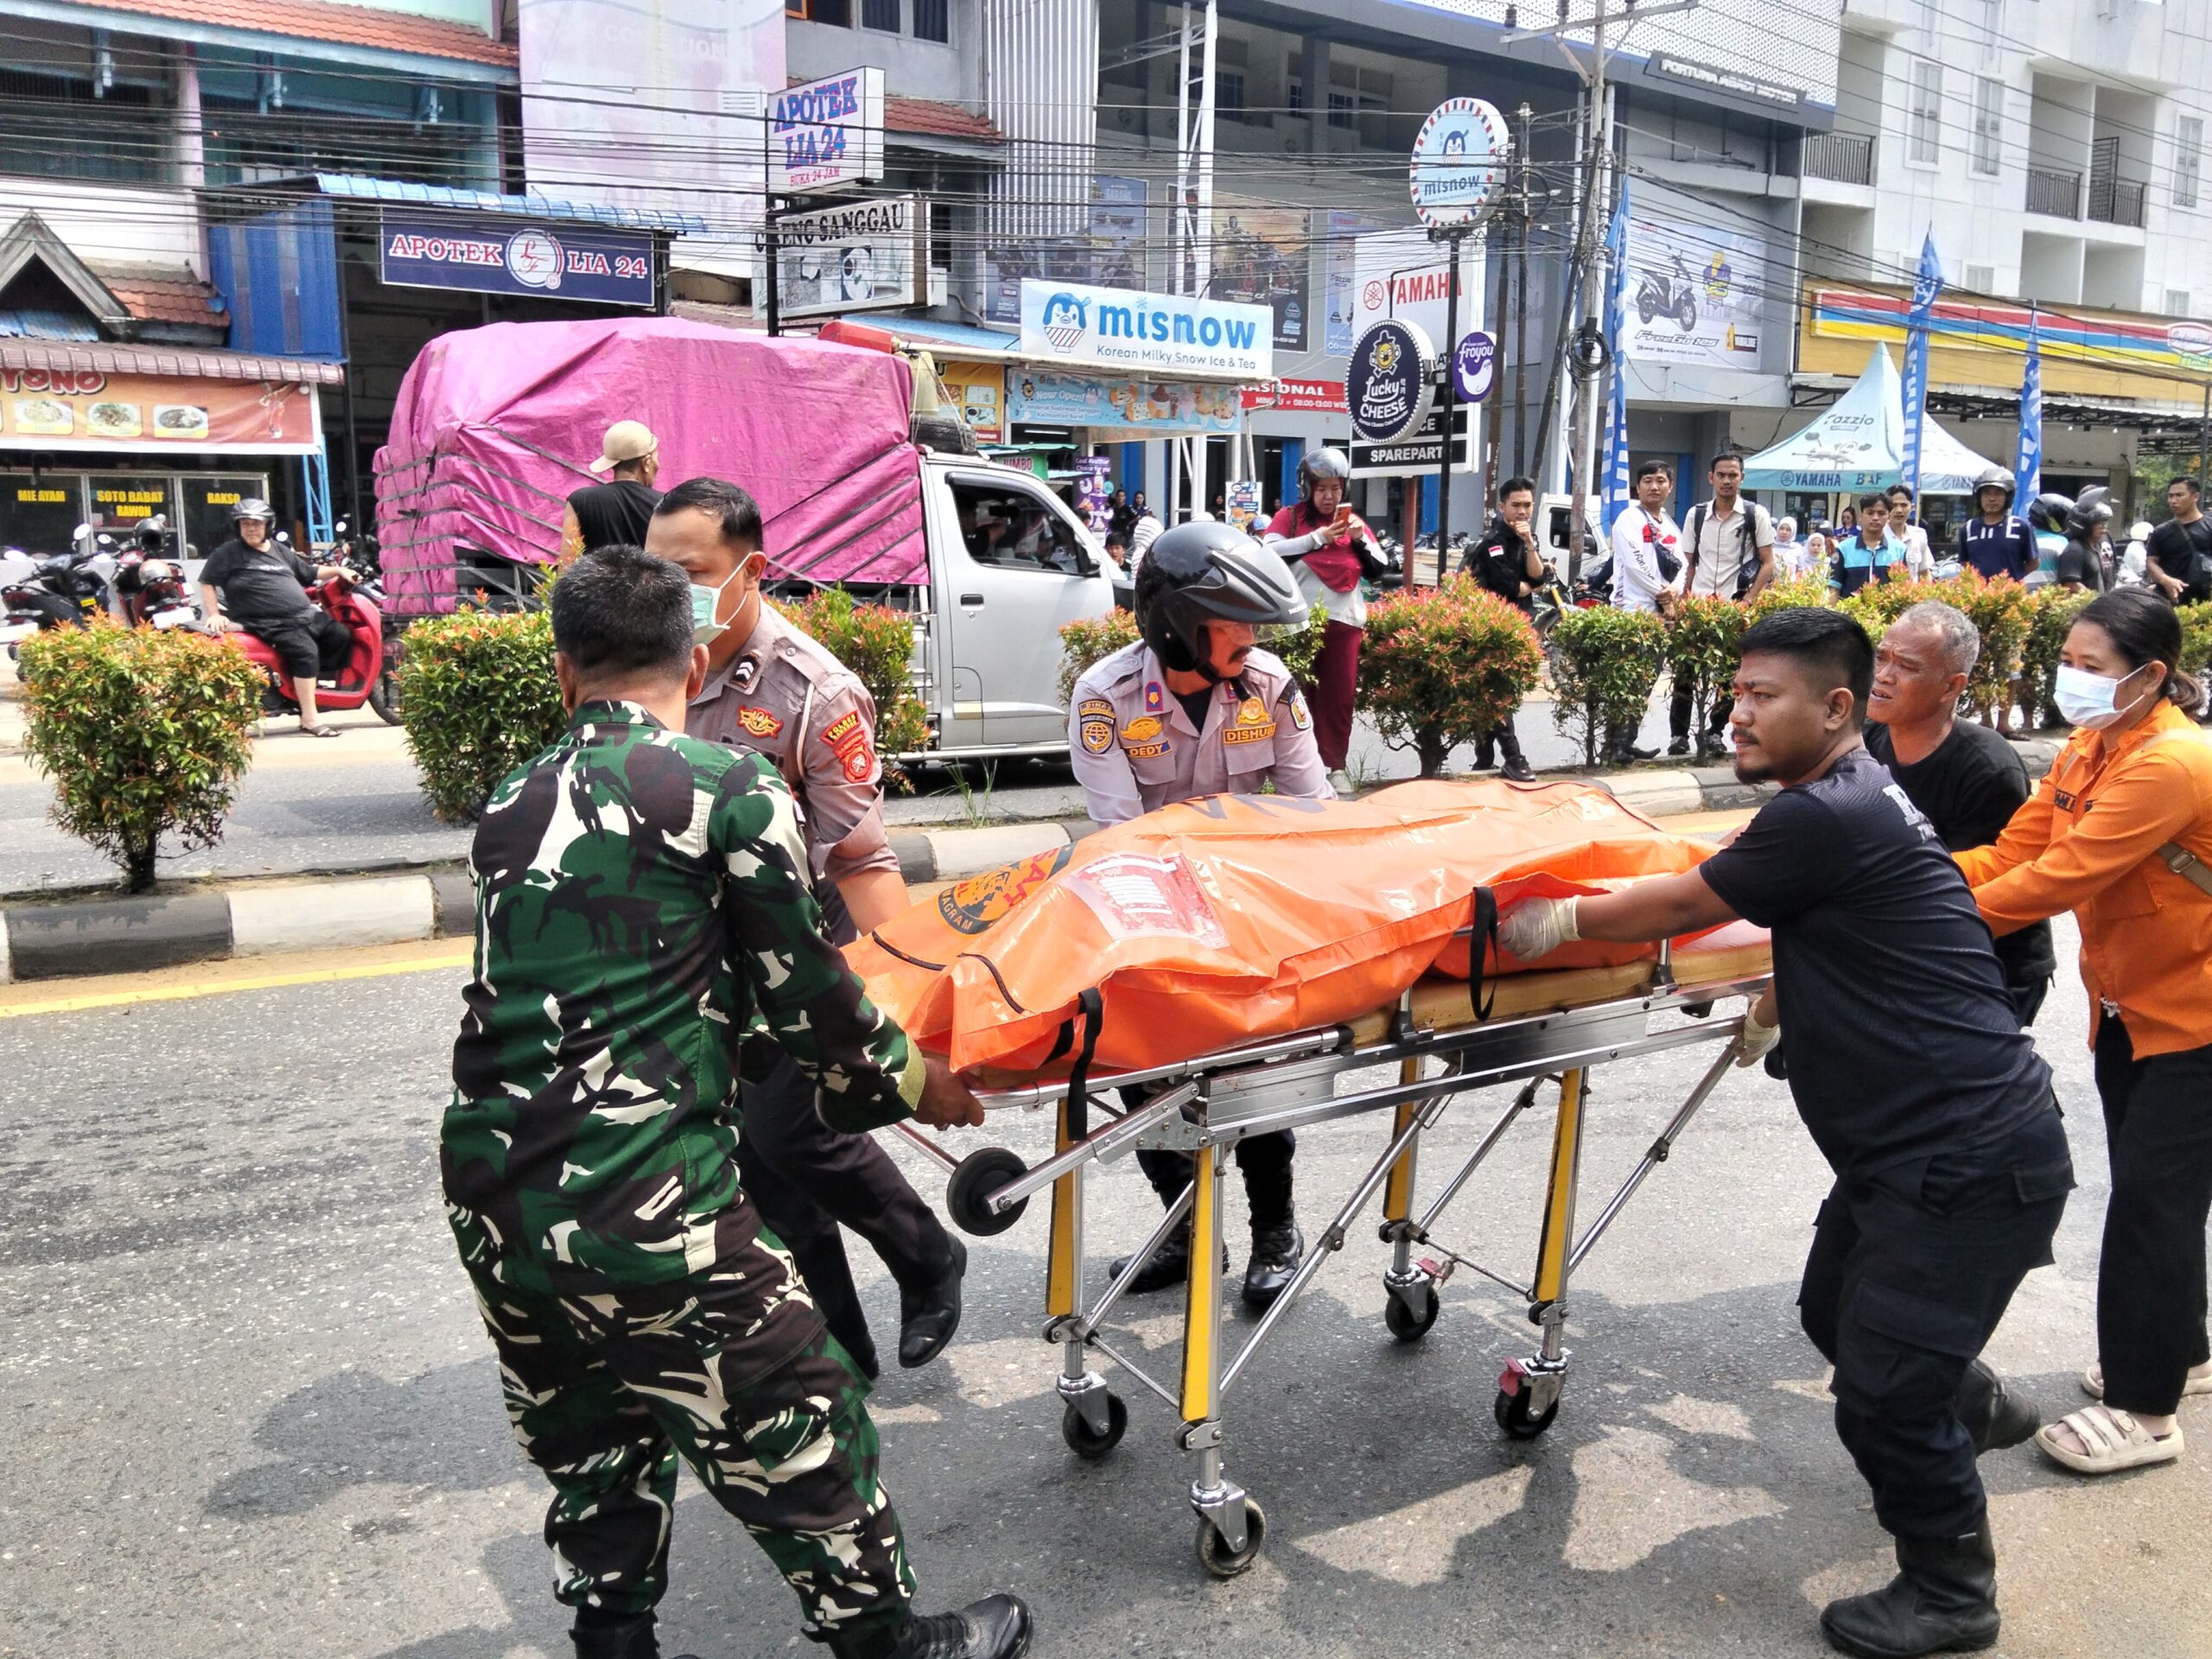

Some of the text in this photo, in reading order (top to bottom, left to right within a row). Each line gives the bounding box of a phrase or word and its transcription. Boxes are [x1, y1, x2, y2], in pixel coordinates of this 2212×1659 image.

[774, 75, 859, 133] APOTEK
[785, 123, 847, 171] LIA 24
[1424, 175, 1480, 196] misnow
[819, 203, 905, 243] SANGGAU
[389, 234, 648, 278] APOTEK LIA 24
[1098, 298, 1256, 350] misnow
[1096, 345, 1256, 370] Korean Milky Snow Ice & Tea
[1459, 342, 1494, 364] froyou
[1037, 391, 1085, 404] Now Open!
[1362, 376, 1400, 404] Lucky
[1359, 396, 1408, 419] CHEESE
[1370, 446, 1443, 462] SPAREPART
[1794, 473, 1841, 486] YAMAHA
[17, 490, 67, 502] MIE AYAM
[97, 490, 164, 503] SOTO BABAT
[1129, 745, 1163, 757] DEDY
